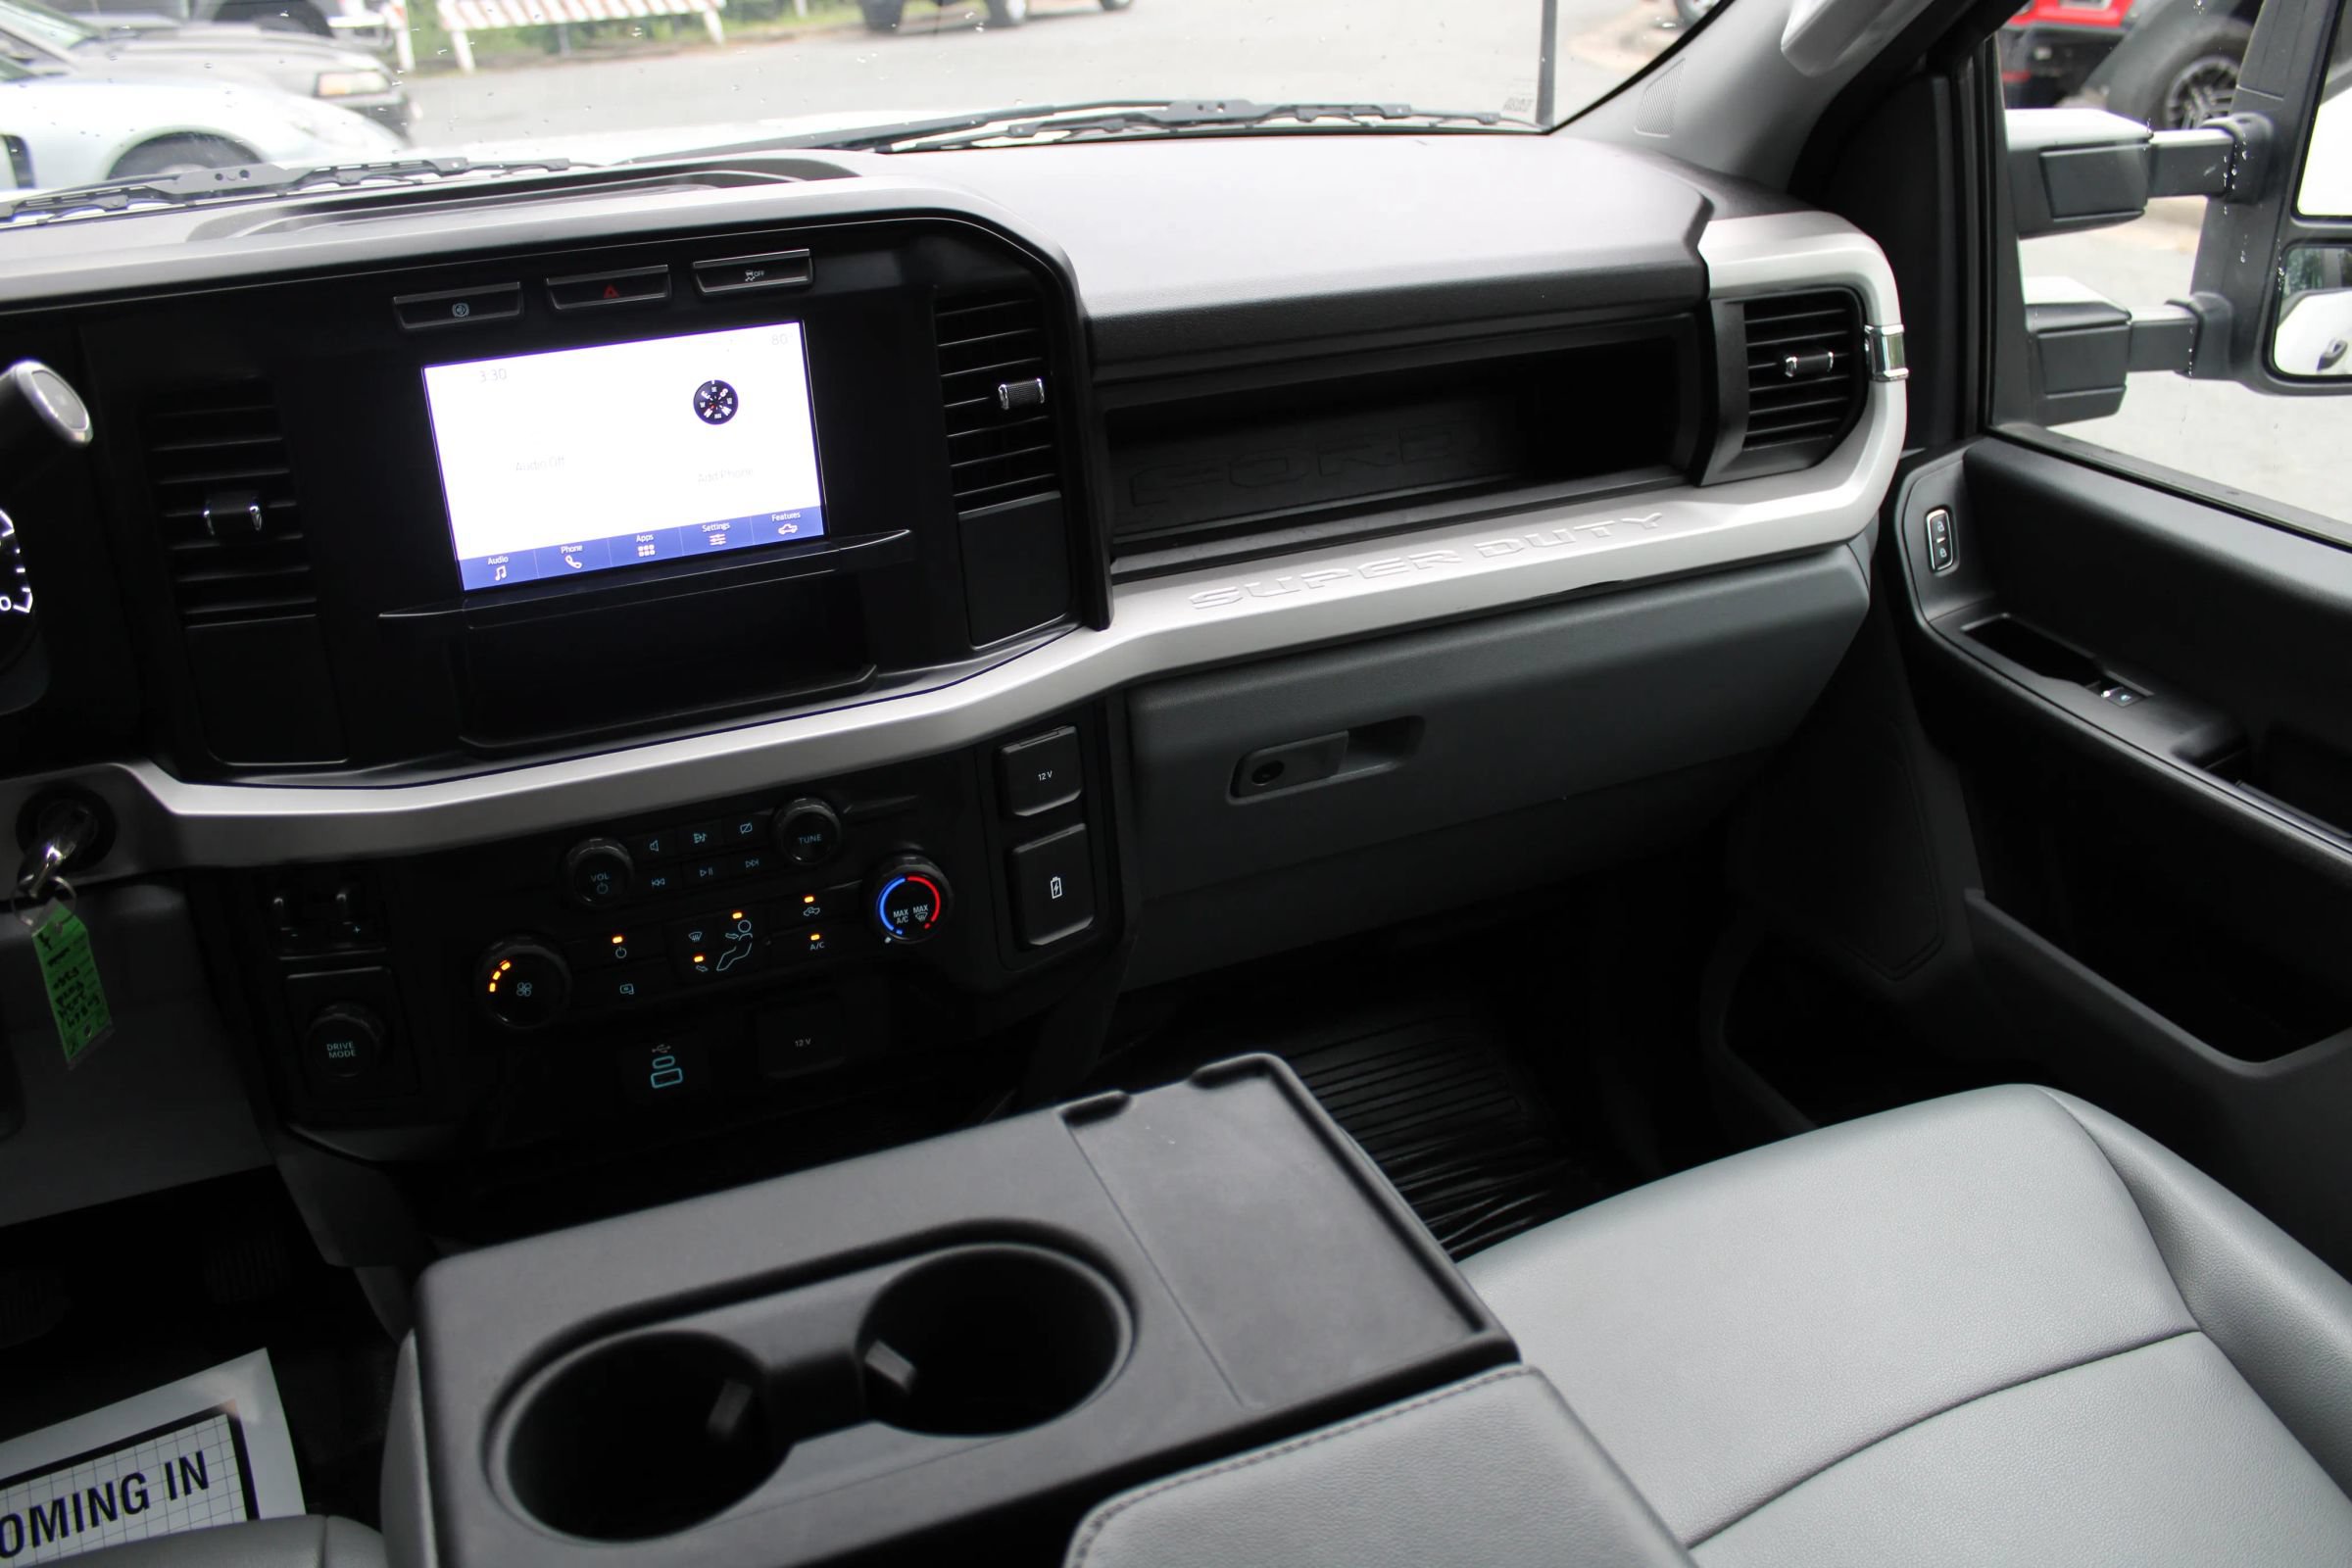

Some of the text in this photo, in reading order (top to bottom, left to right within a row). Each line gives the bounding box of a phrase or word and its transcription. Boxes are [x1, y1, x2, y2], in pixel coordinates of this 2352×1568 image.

[771, 511, 801, 521] Features
[702, 520, 730, 533] Settings
[635, 533, 654, 545] Apps
[561, 544, 583, 555] Phone
[487, 556, 509, 565] Audio
[1188, 512, 1663, 610] SUPER DUTY
[799, 833, 822, 846] TUNE
[590, 871, 610, 883] VOL
[893, 908, 909, 918] MAX
[912, 904, 929, 914] MAX
[896, 915, 909, 925] A/C
[809, 941, 825, 952] A/C
[326, 1040, 354, 1052] DRIVE
[328, 1049, 357, 1059] MODE
[164, 1449, 210, 1501] IN
